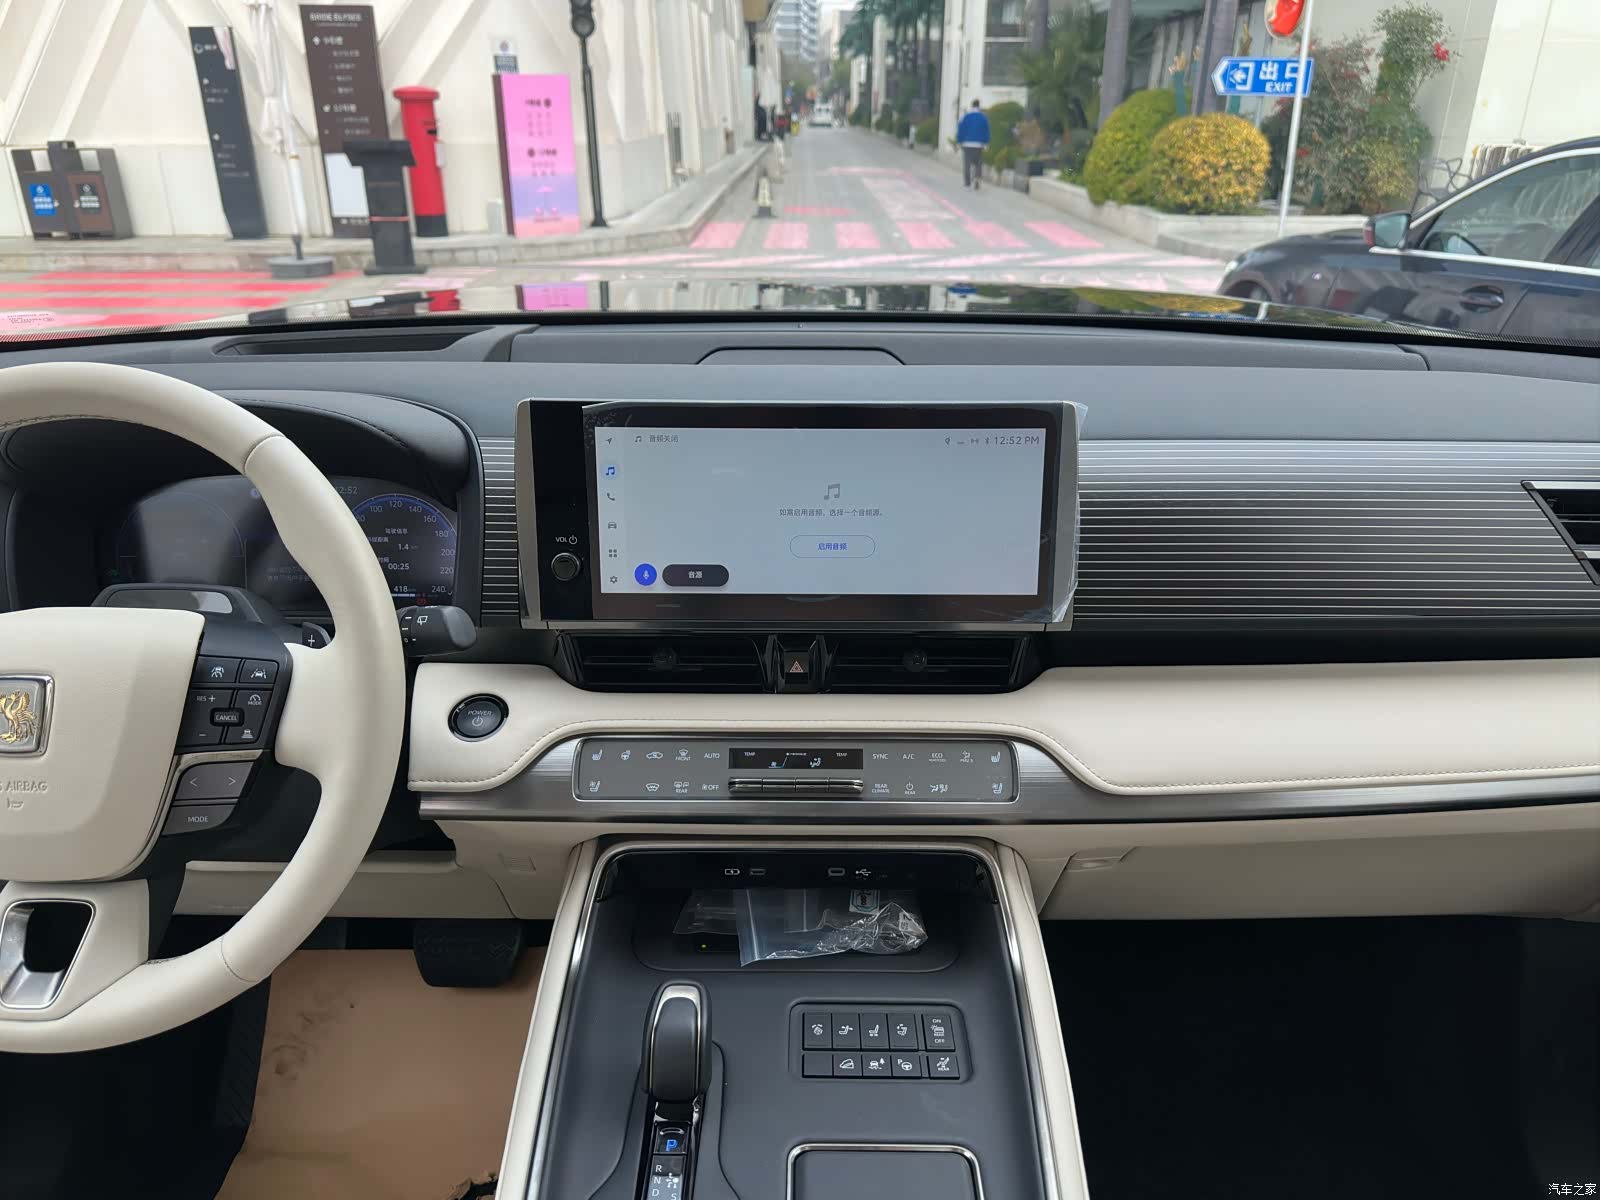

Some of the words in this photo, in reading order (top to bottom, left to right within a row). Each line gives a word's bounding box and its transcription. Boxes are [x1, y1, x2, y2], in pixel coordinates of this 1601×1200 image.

[1259, 61, 1300, 81] 出口
[1265, 81, 1293, 92] EXIT
[649, 434, 679, 443] 音频关闭
[994, 436, 1022, 445] 12:52
[1024, 436, 1040, 445] PM
[435, 530, 449, 538] 180
[818, 542, 847, 551] 启用音频
[688, 570, 703, 579] 音源
[431, 585, 446, 593] 240
[5, 780, 48, 792] AIRBAG
[665, 1139, 678, 1152] P
